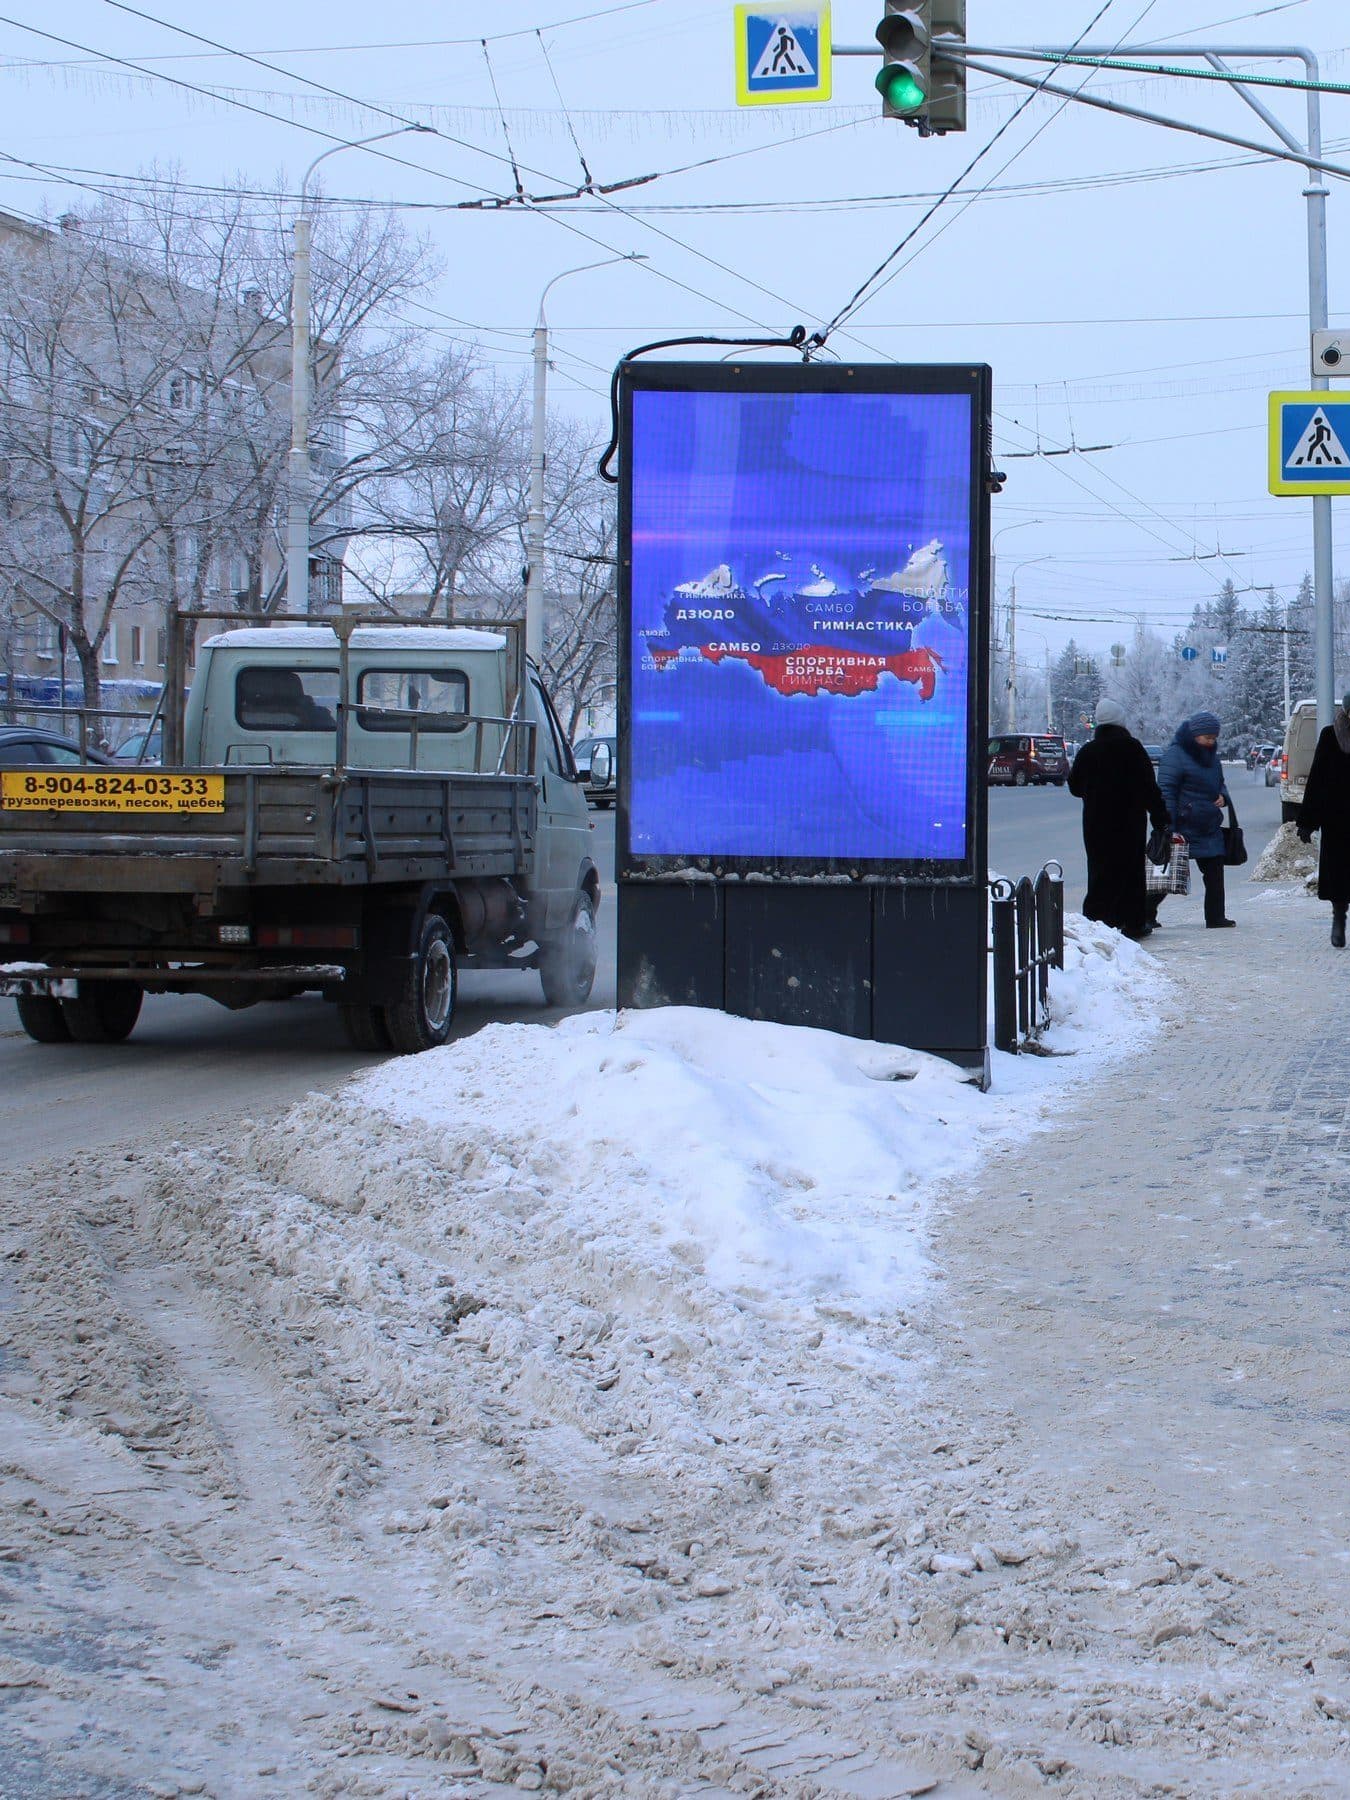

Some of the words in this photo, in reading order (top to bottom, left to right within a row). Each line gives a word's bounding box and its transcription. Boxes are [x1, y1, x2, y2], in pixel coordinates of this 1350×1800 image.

[805, 603, 855, 613] САМБО
[676, 609, 735, 621] ДЗЮДО
[813, 621, 914, 631] ГИМНАСТИКА
[708, 642, 761, 652] САМБО
[771, 642, 811, 651] ДЗЮДО
[641, 655, 704, 663] СПОРТИВНАЯ
[785, 656, 887, 666] СПОРТИВНАЯ
[641, 663, 677, 671] БОРЬБА
[785, 666, 844, 676] БОРЬБА
[781, 675, 877, 686] ГИМНАС
[25, 776, 208, 795] 8-904-824-03-33
[125, 799, 173, 809] песок,
